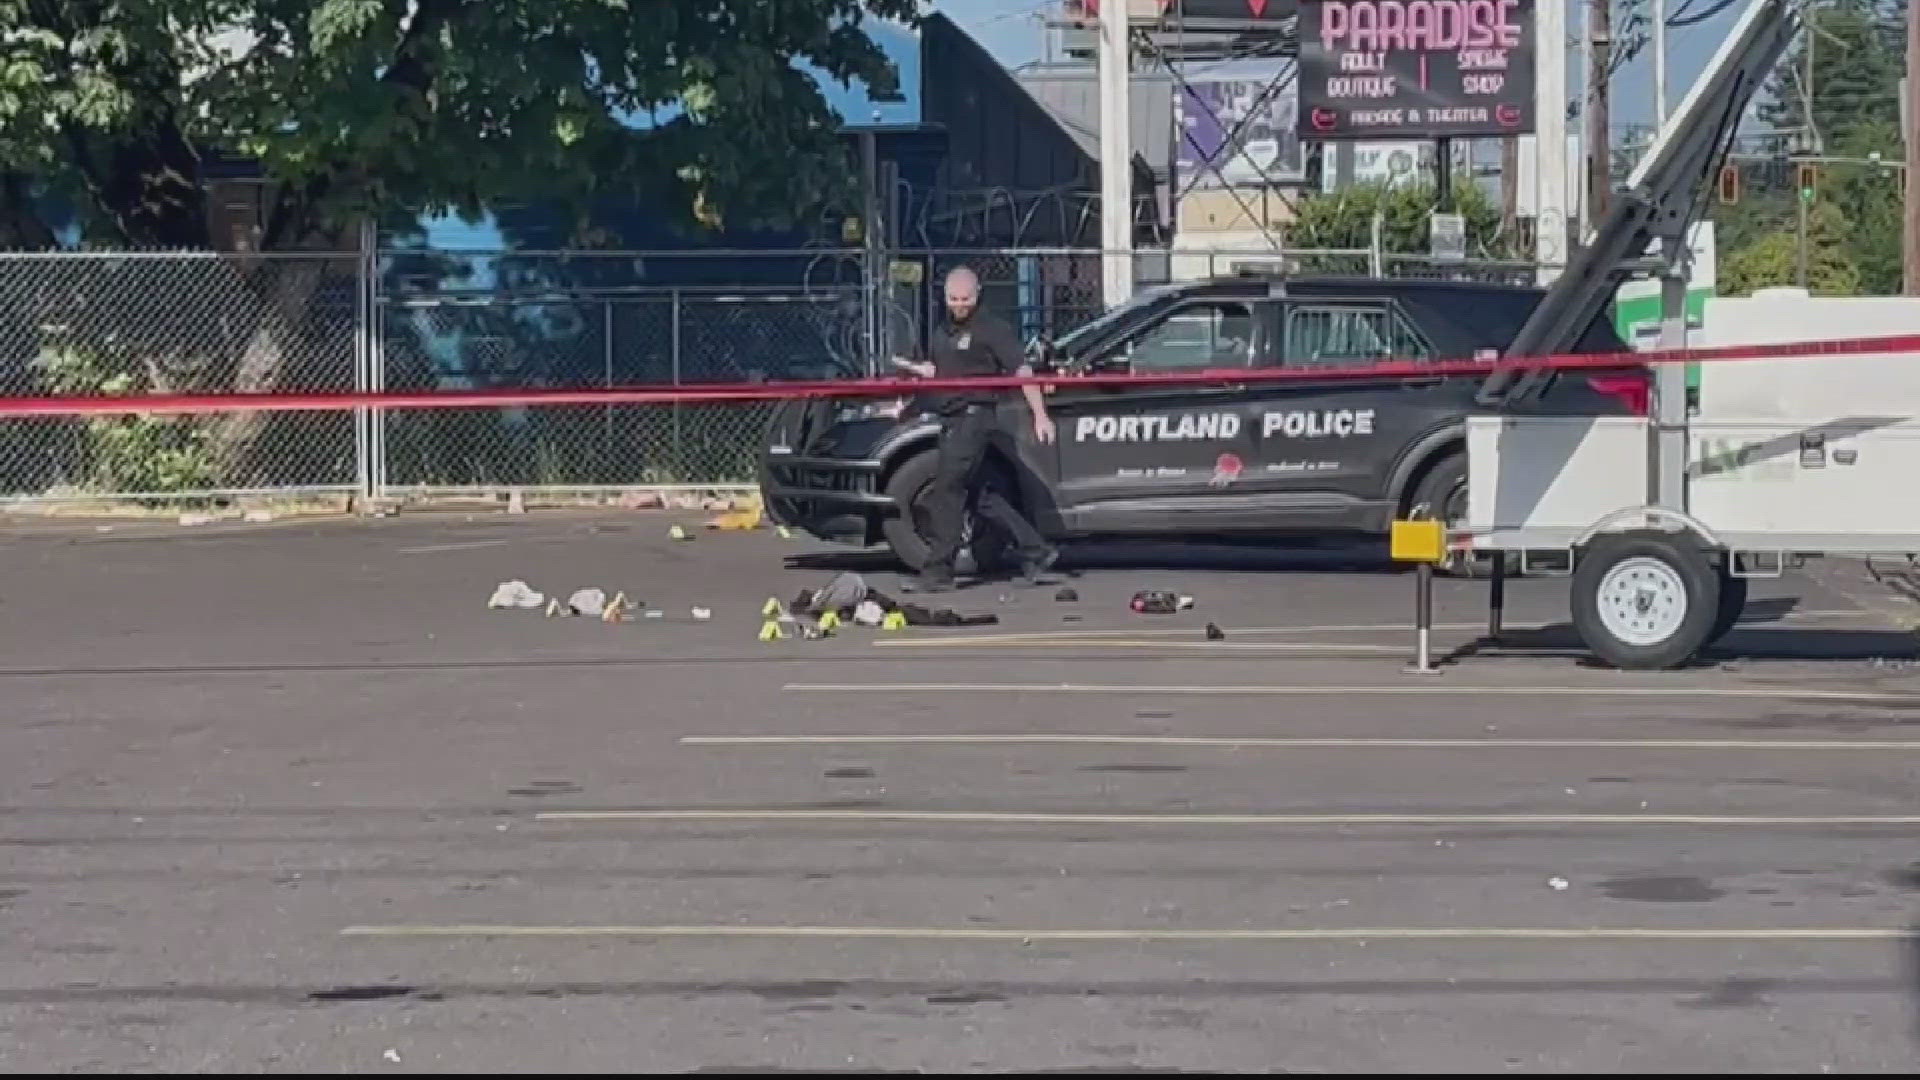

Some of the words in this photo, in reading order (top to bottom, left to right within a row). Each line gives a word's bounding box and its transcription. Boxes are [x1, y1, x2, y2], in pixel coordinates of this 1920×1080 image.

[1320, 1, 1521, 50] PARADISE
[1341, 53, 1385, 70] ADULT
[1075, 413, 1240, 442] PORTLAND
[1263, 409, 1375, 439] POLICE
